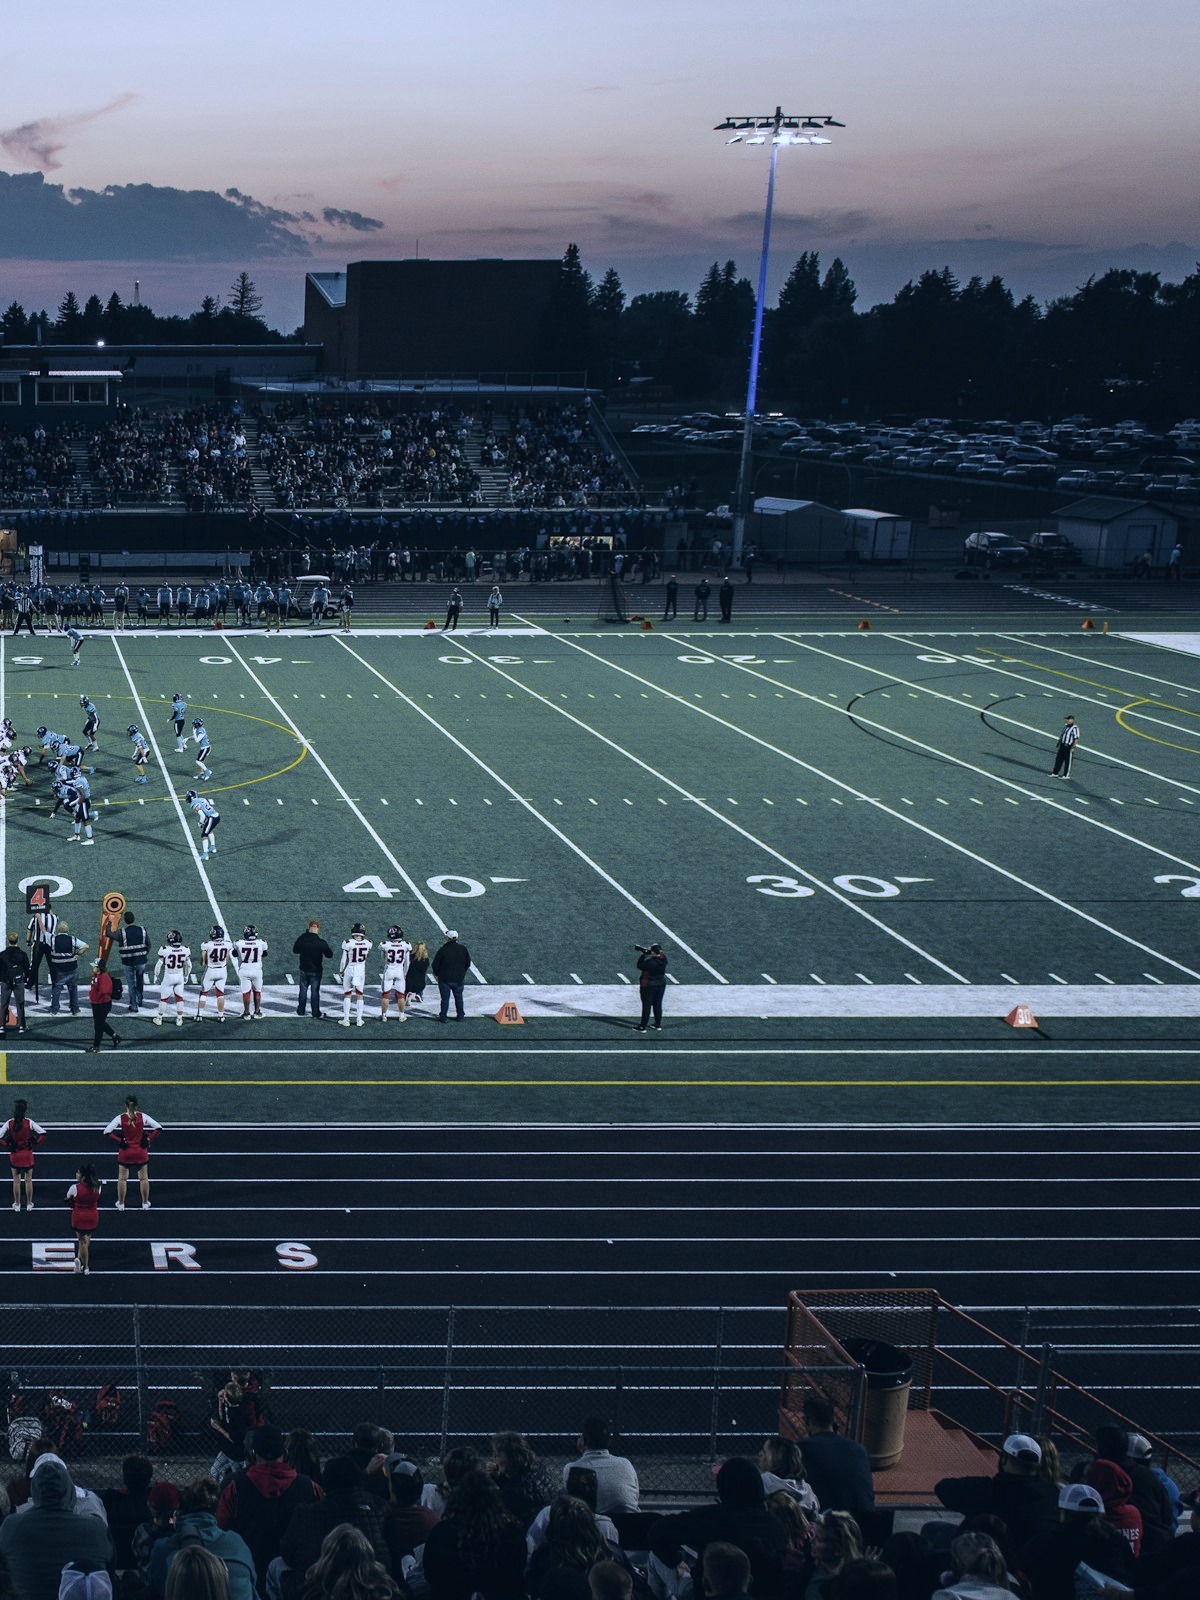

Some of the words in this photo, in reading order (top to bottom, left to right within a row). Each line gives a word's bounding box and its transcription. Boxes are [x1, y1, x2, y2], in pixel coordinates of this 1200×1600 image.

[341, 875, 486, 898] 40
[746, 875, 901, 898] 30
[30, 887, 46, 906] 4
[167, 954, 186, 968] 35
[210, 948, 228, 962] 40
[242, 948, 259, 964] 71
[352, 948, 367, 962] 15
[387, 950, 404, 964] 33
[505, 1006, 517, 1022] 40
[1018, 1008, 1032, 1024] 30
